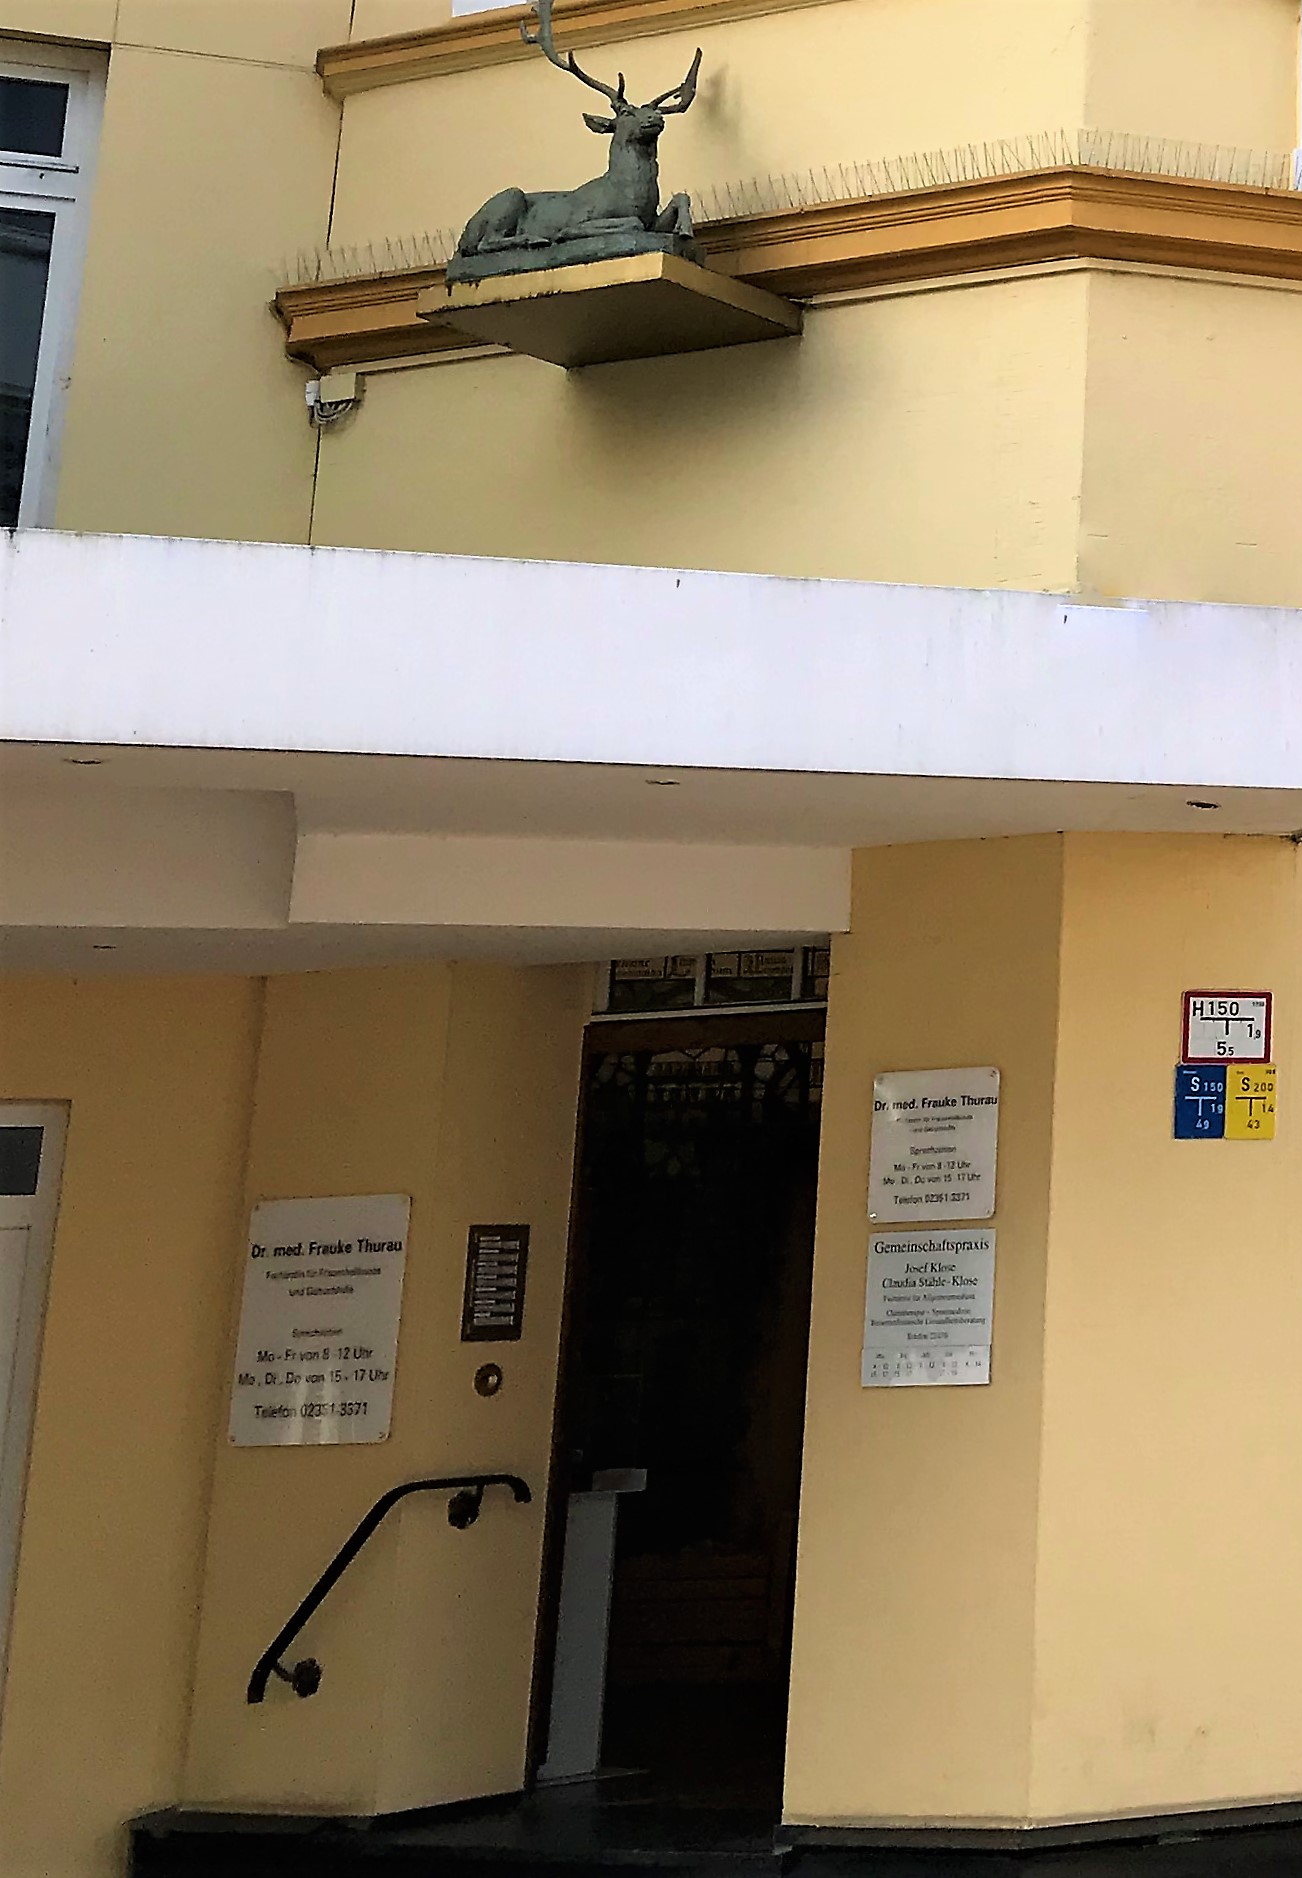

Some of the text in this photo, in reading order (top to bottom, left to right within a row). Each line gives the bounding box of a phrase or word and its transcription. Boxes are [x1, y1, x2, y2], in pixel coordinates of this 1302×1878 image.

[1190, 1077, 1223, 1092] S 150
[1241, 1077, 1273, 1092] S 200
[893, 1099, 918, 1110] med.
[922, 1096, 957, 1108] Frauke
[961, 1095, 998, 1106] Thurau
[273, 1242, 304, 1257] med.
[309, 1239, 352, 1256] Frauke
[357, 1237, 403, 1253] Thurau
[874, 1237, 990, 1255] Gemeinschaftspraxis
